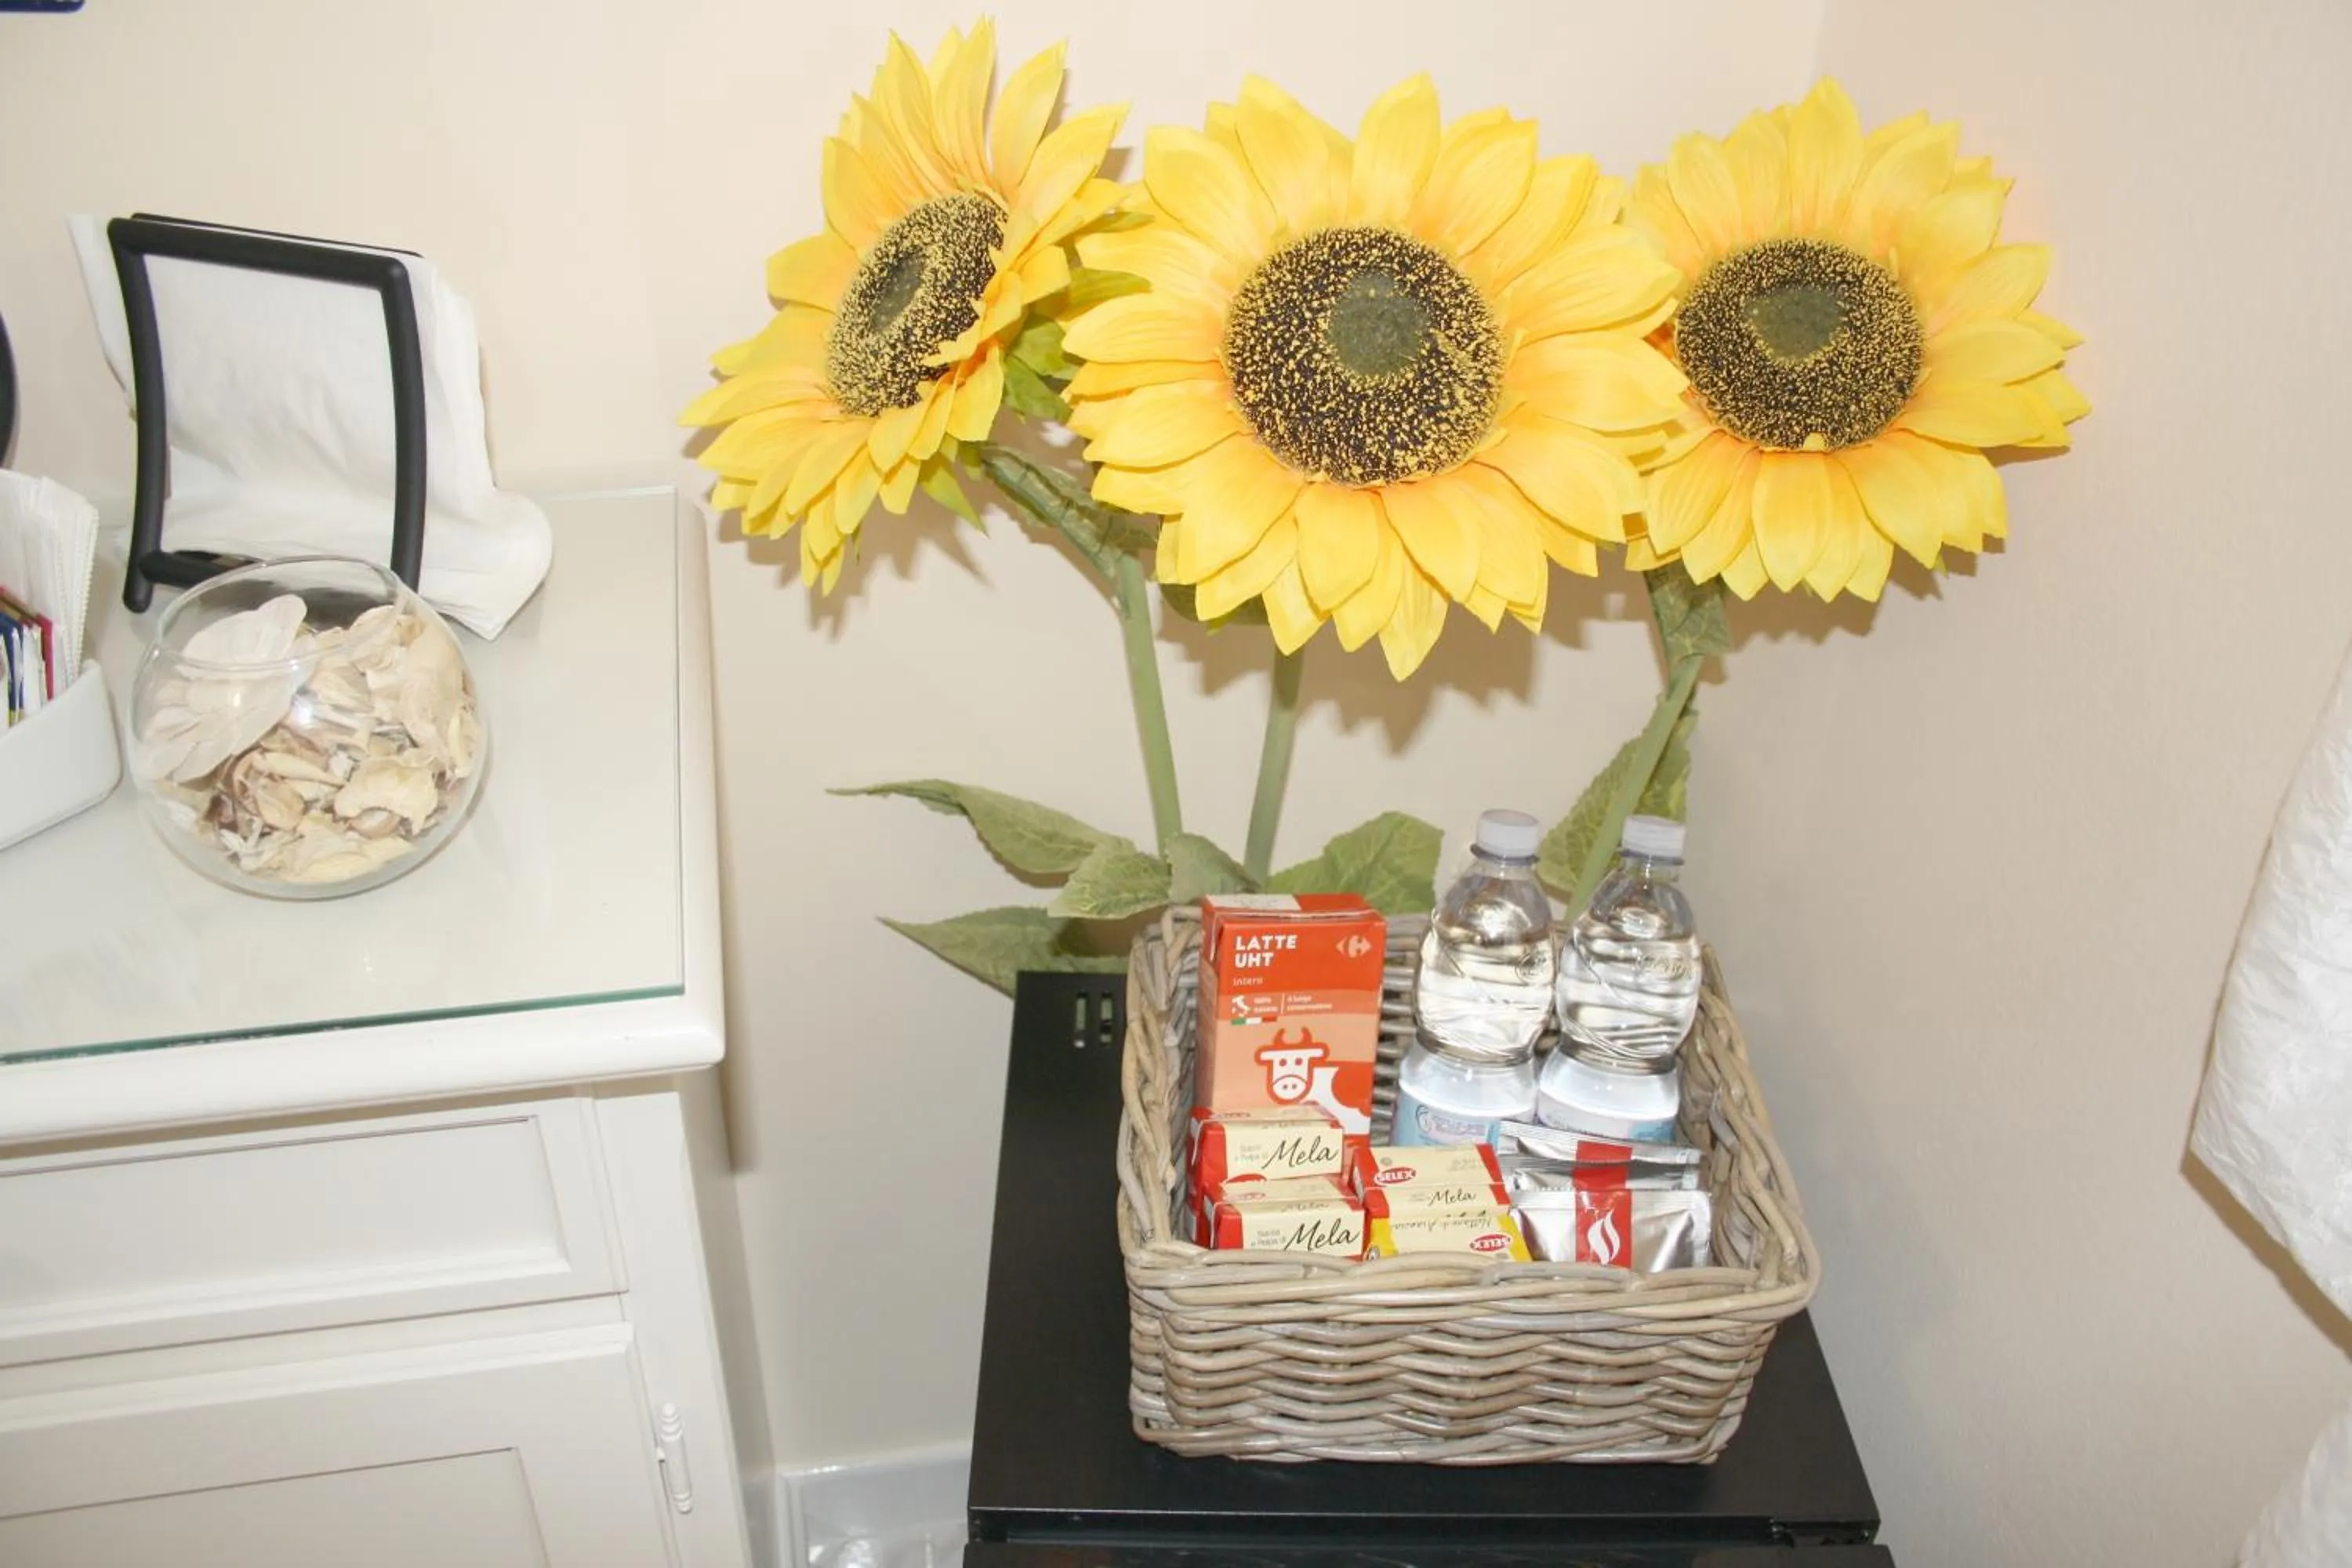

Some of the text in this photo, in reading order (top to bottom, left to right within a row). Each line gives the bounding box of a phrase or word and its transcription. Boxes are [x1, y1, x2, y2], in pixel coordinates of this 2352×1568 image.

[1236, 934, 1298, 951] LATTE
[1235, 953, 1274, 968] UHT
[1261, 1134, 1339, 1170] Mela
[1376, 1169, 1414, 1182] SELEX
[1428, 1188, 1476, 1206] Mela
[1283, 1217, 1360, 1252] Mela
[1473, 1236, 1509, 1250] SELEX
